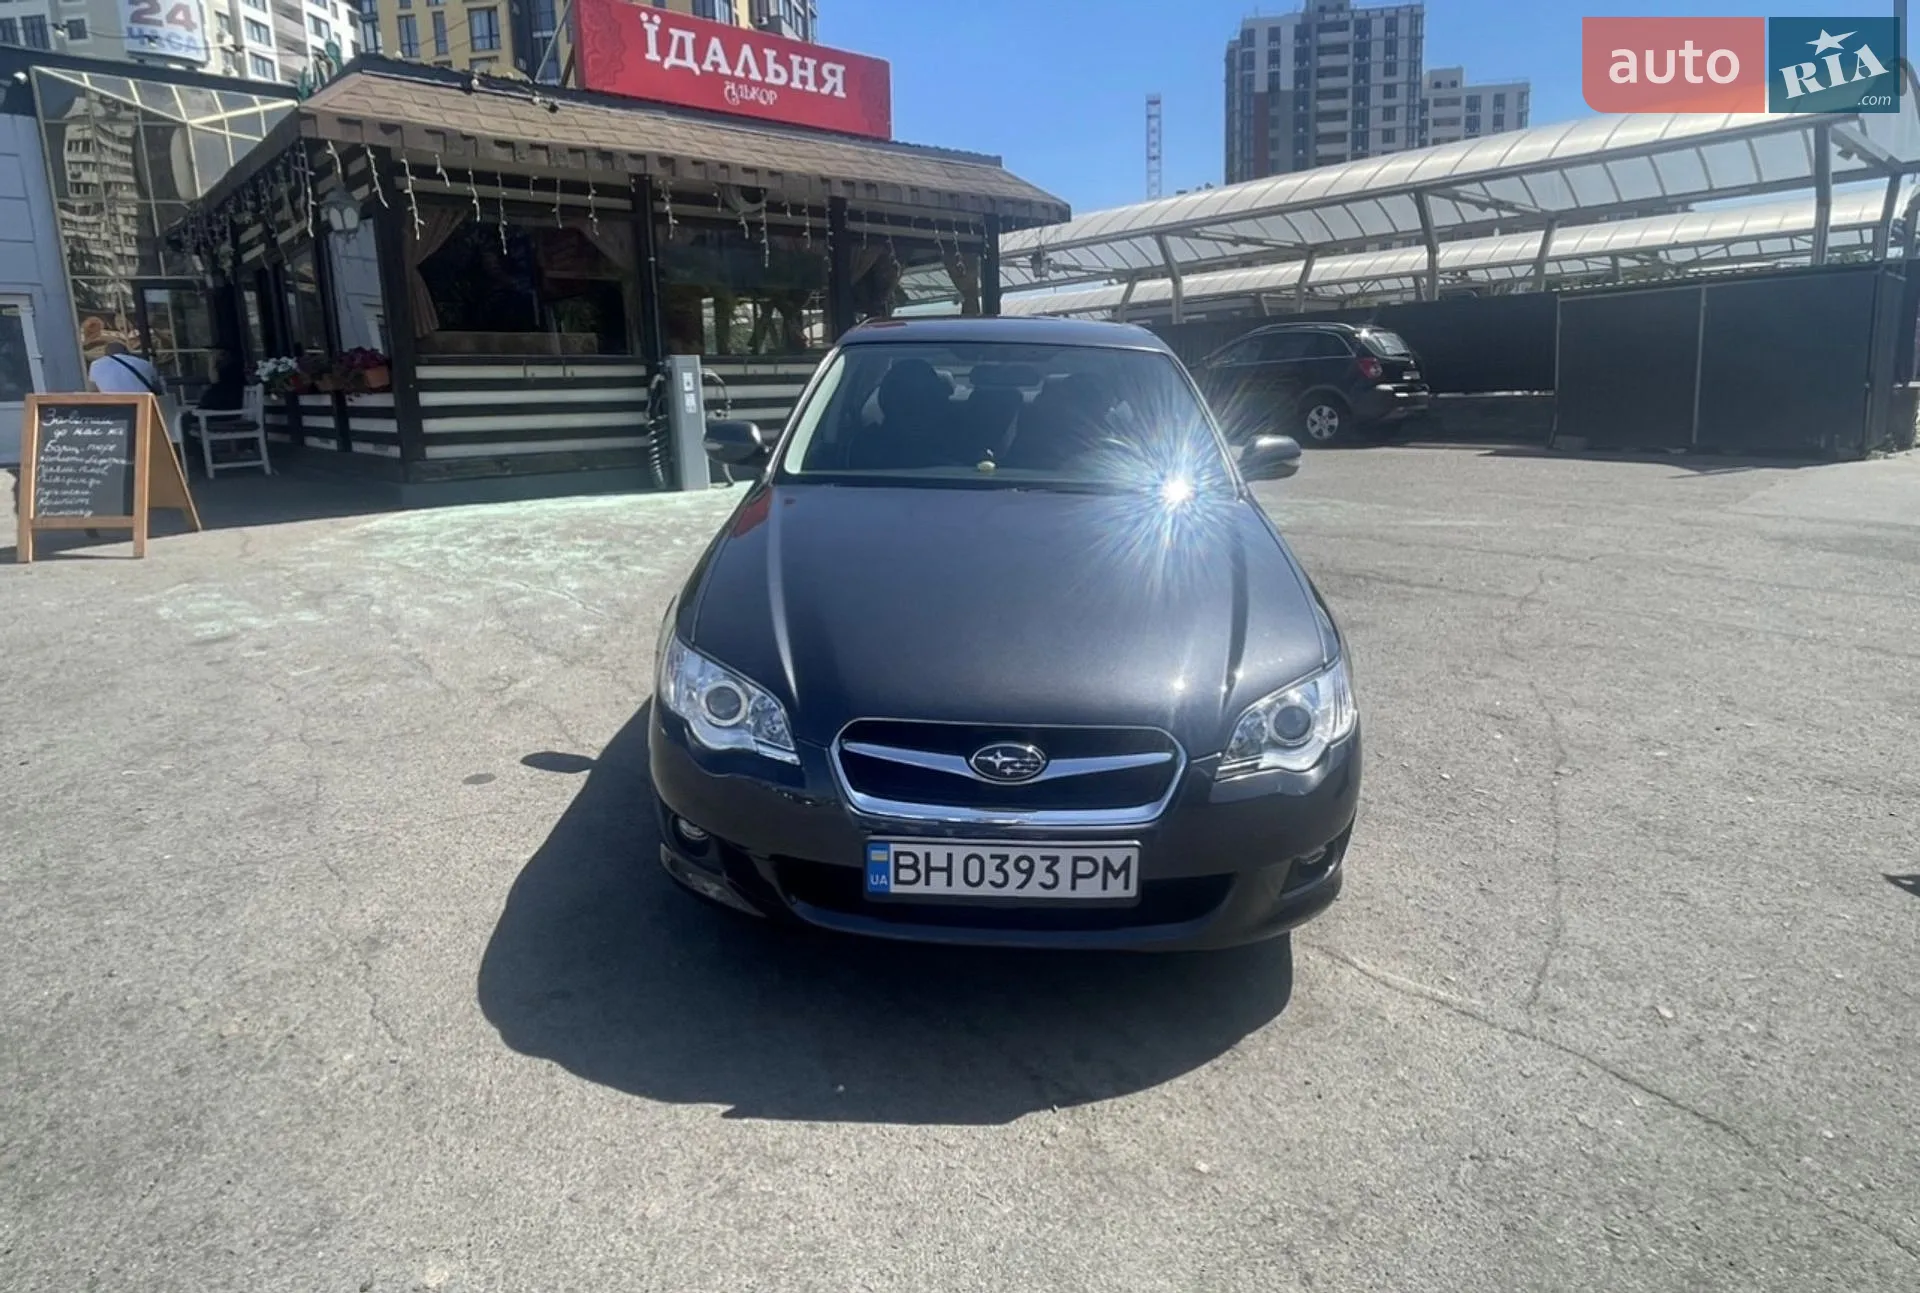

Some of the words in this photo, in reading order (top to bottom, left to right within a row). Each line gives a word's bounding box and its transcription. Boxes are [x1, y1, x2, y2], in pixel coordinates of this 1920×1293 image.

[128, 0, 198, 32] 24
[639, 11, 848, 99] ЇДАЛЬНЯ
[73, 427, 104, 437] нас
[870, 874, 889, 886] UA
[962, 852, 1060, 891] 0393
